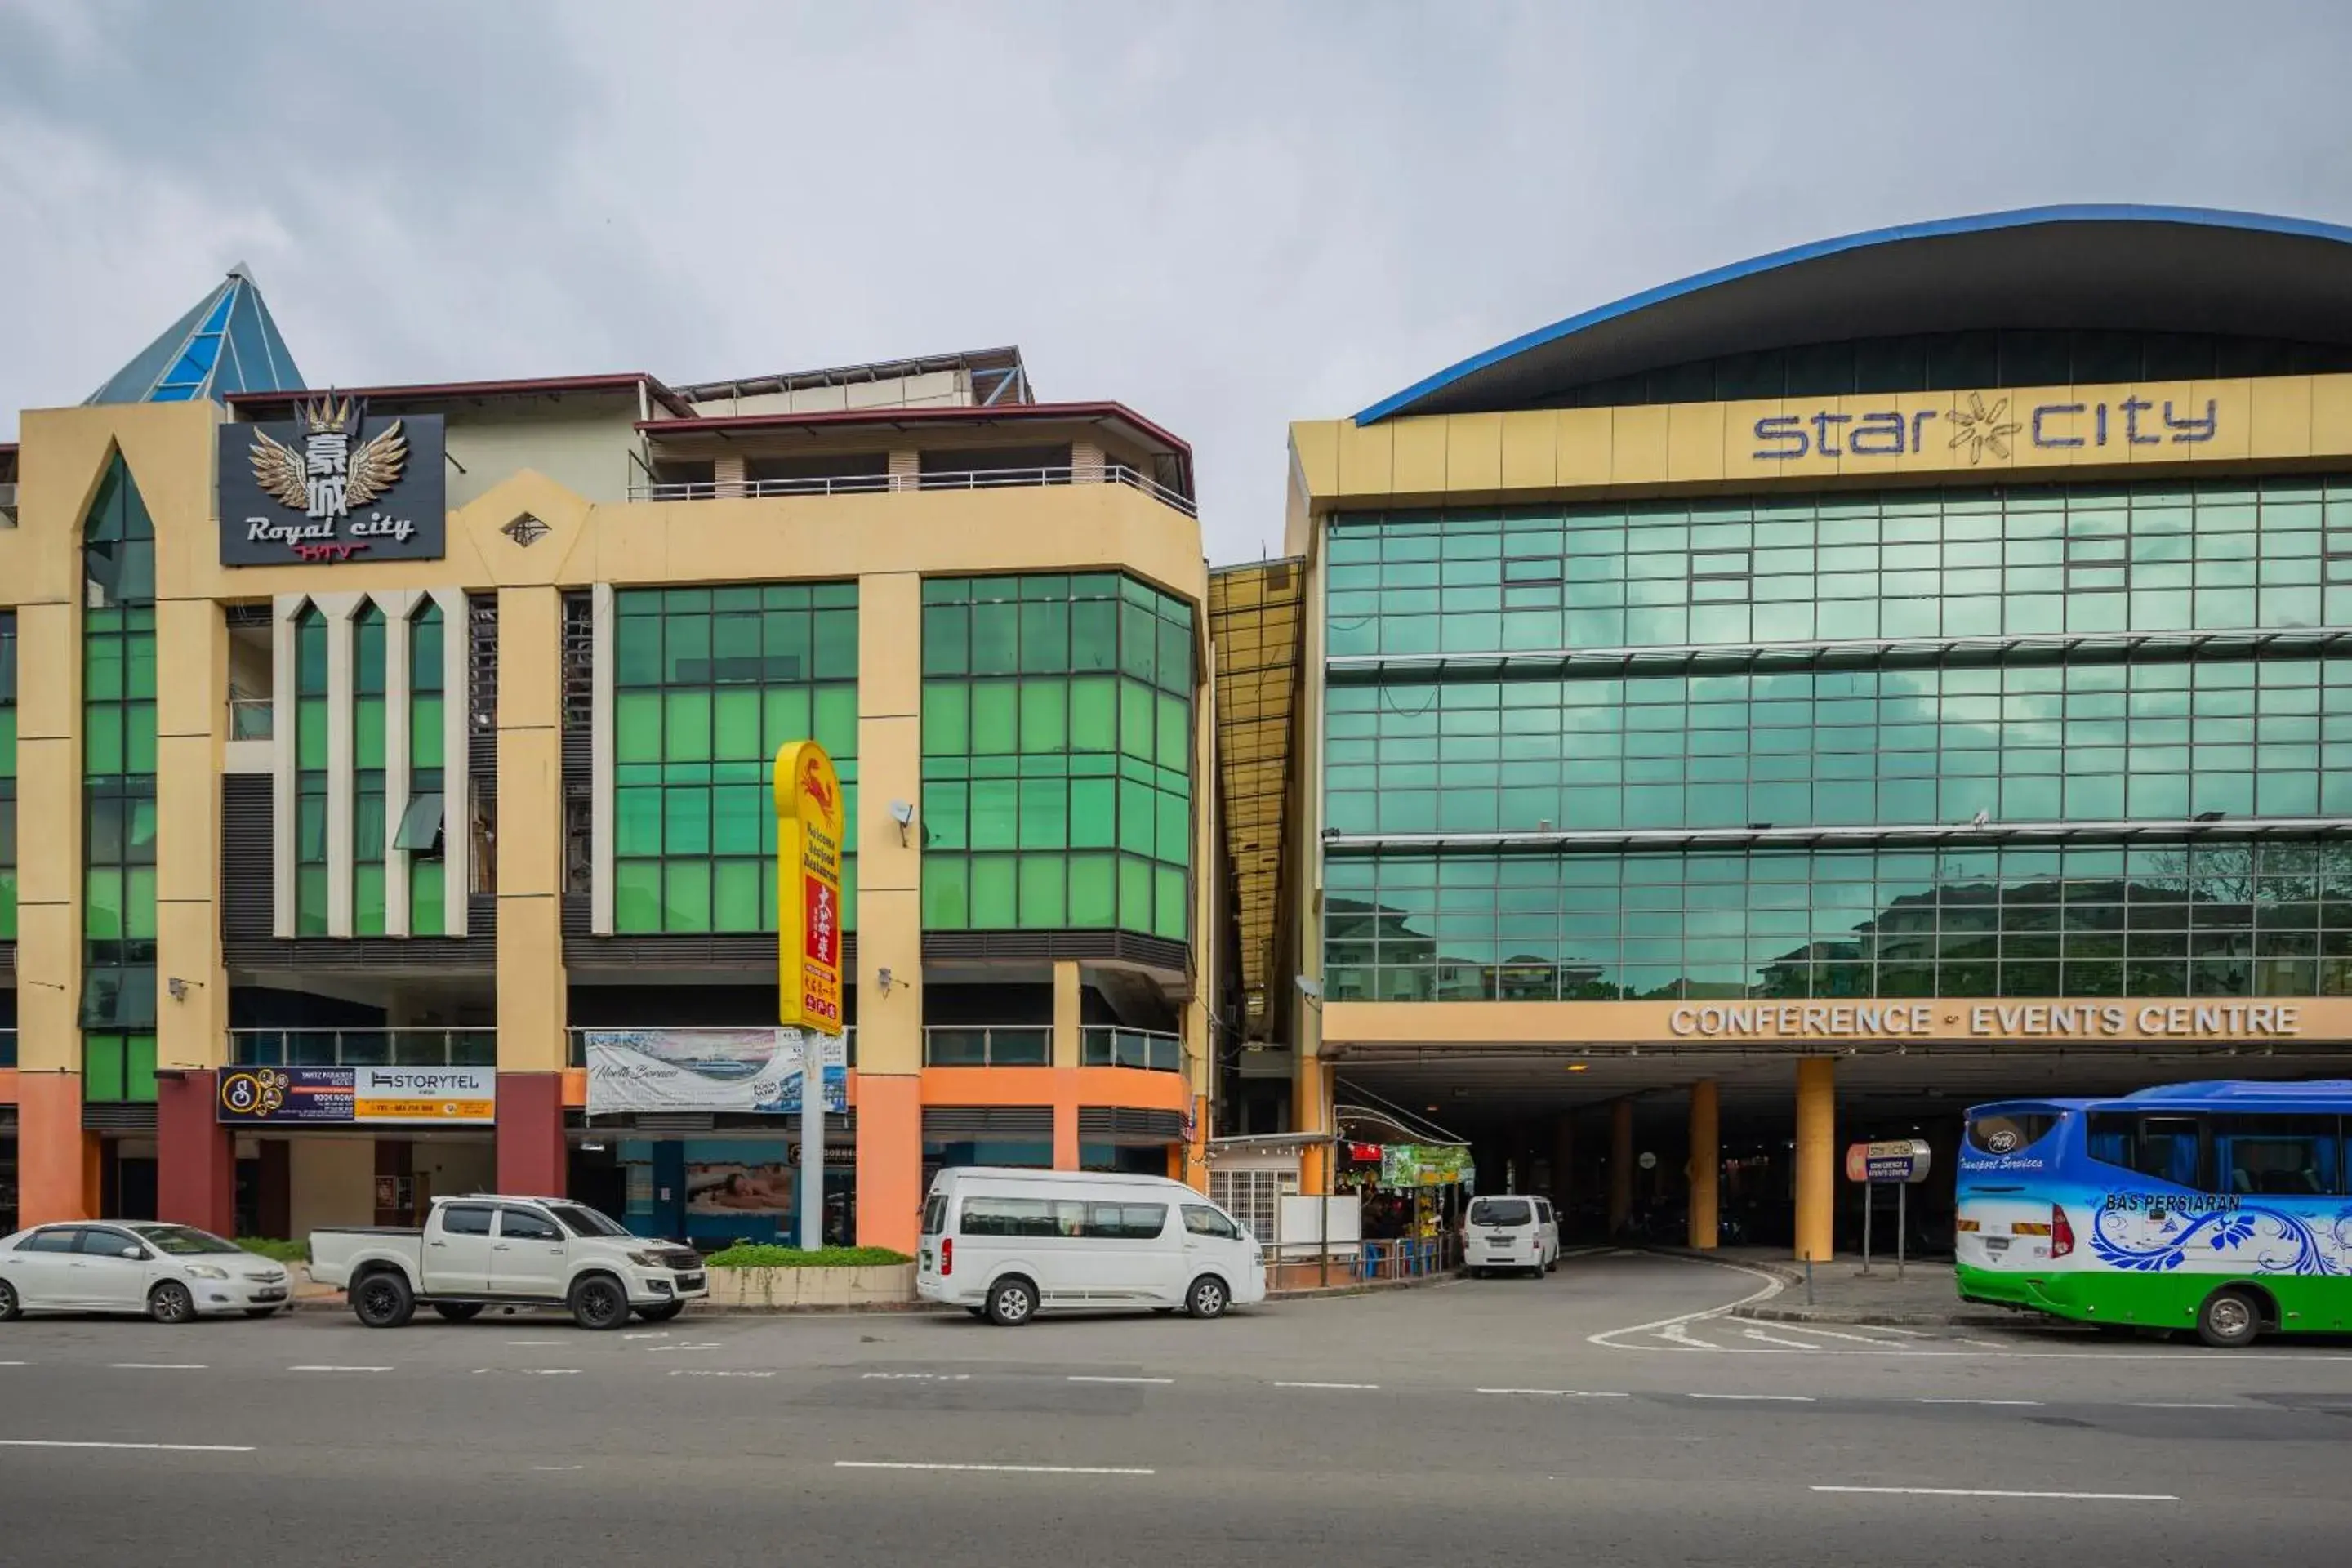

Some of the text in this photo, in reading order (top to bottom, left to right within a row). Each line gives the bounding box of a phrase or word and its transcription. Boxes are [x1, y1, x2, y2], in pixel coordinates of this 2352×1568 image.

[1753, 394, 2217, 459] star city
[305, 434, 349, 518] 豪城
[245, 512, 414, 546] Royal city
[290, 543, 370, 561] KTV
[1671, 1004, 1936, 1036] CONFERENCE
[1971, 1004, 2125, 1036] EVENTS
[2137, 1004, 2301, 1036] CENTRE
[394, 1075, 479, 1089] STORYTEL
[2106, 1193, 2241, 1212] BAS PERSIARAN
